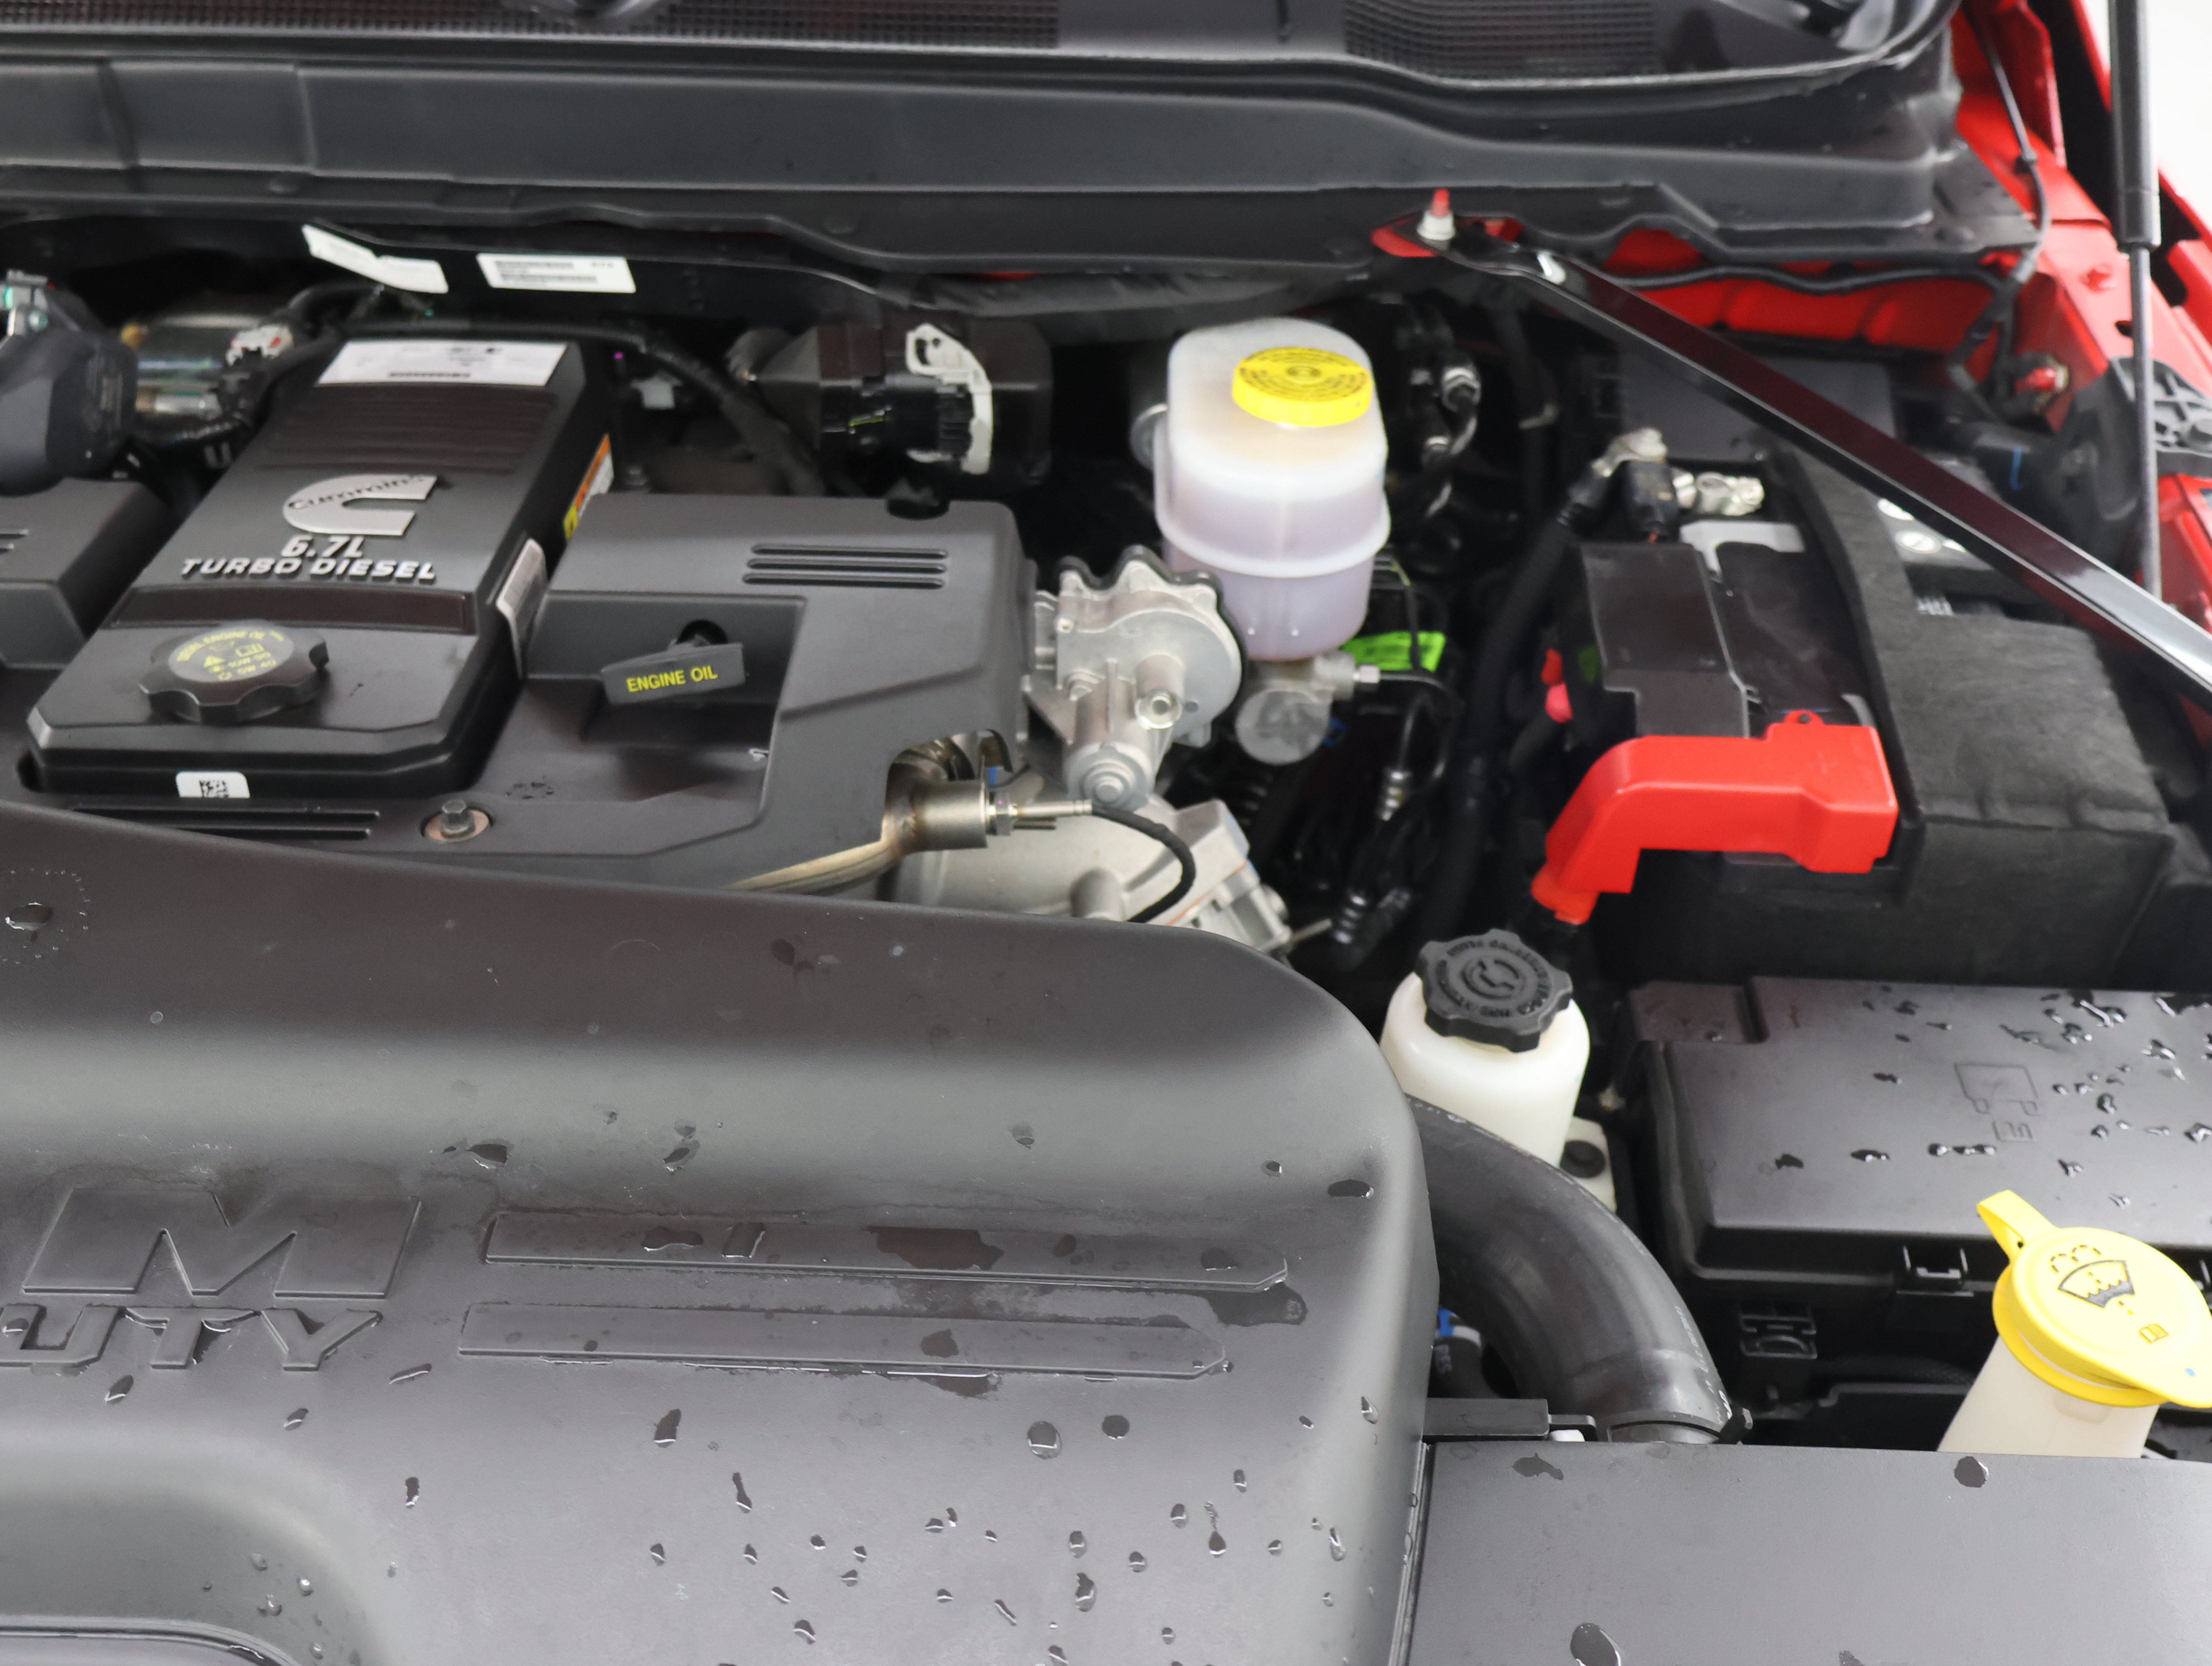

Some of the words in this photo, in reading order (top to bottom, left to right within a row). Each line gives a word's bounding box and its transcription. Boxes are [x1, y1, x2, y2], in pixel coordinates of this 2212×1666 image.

[281, 535, 364, 558] 6.7L
[181, 558, 303, 575] TURBO
[310, 558, 436, 579] DIESEL
[626, 669, 686, 693] ENGINE
[690, 665, 719, 682] OIL
